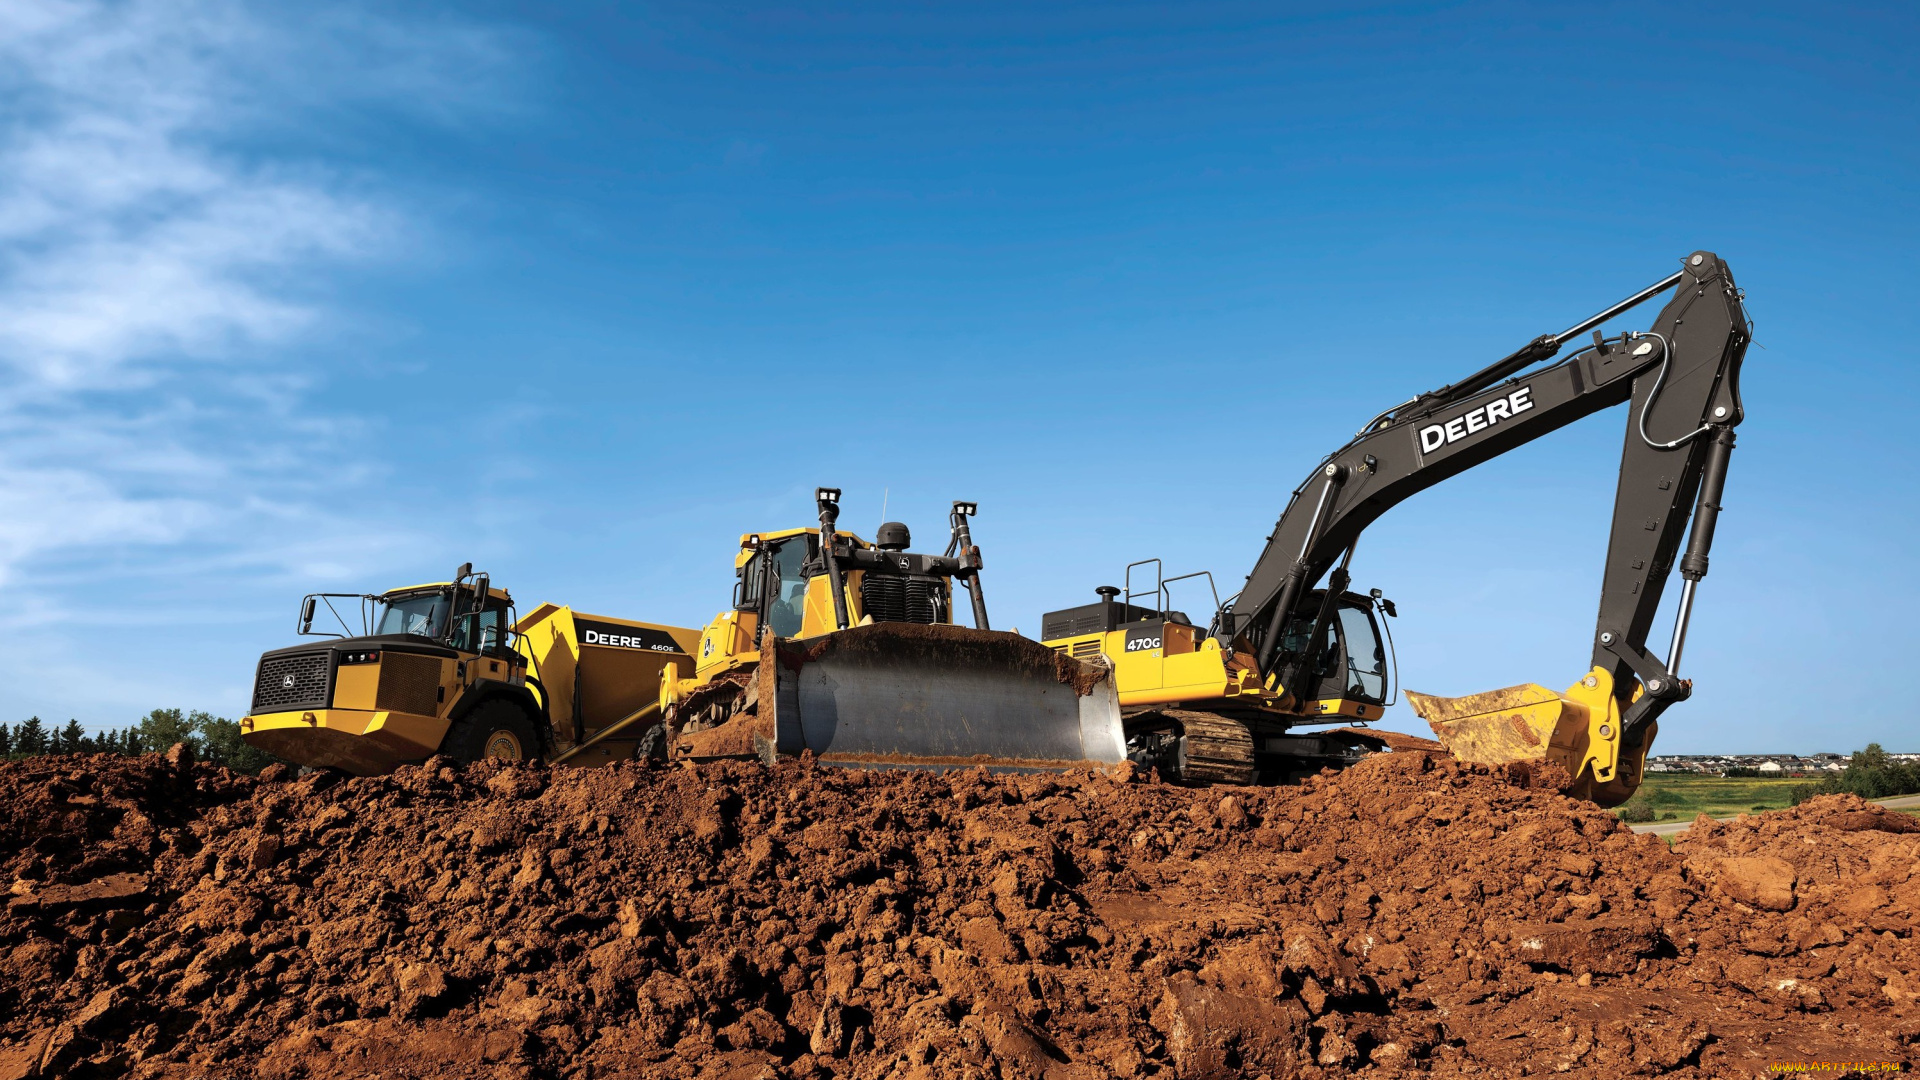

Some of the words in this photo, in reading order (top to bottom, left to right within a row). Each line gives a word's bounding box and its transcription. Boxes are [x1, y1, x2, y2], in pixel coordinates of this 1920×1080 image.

[1420, 387, 1533, 454] DEERE
[585, 630, 642, 648] DEERE
[650, 643, 674, 652] 460E
[1127, 637, 1161, 651] 470G
